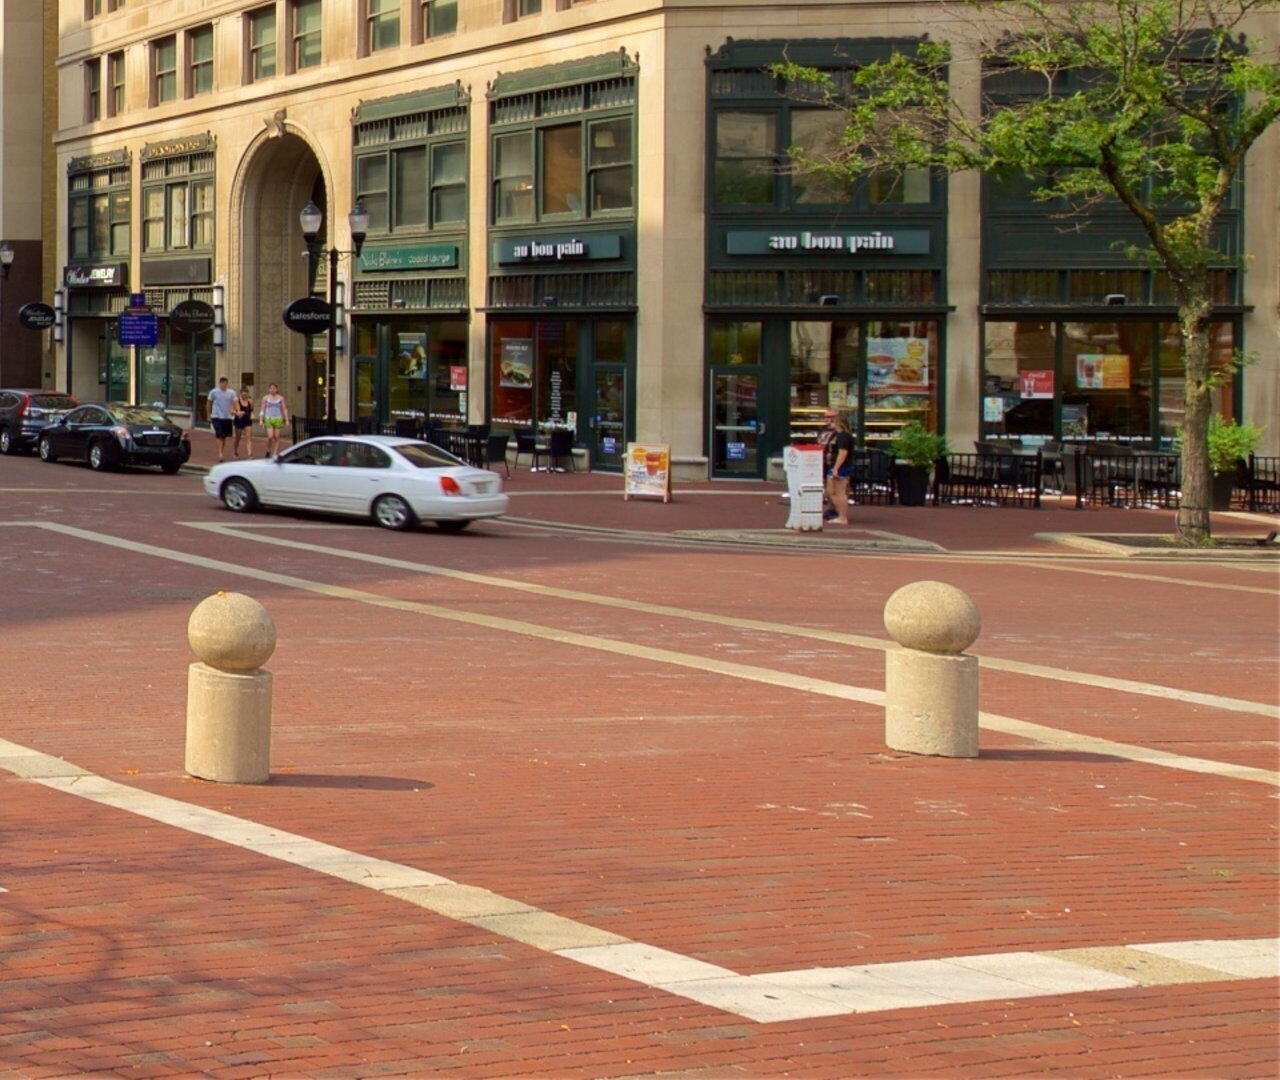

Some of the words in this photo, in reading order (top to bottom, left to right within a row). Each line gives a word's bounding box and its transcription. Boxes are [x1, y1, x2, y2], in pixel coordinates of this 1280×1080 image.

[514, 245, 528, 257] au
[531, 241, 553, 256] bon
[557, 239, 583, 260] pain
[768, 235, 797, 249] au
[801, 232, 842, 249] bon
[847, 231, 894, 253] pain
